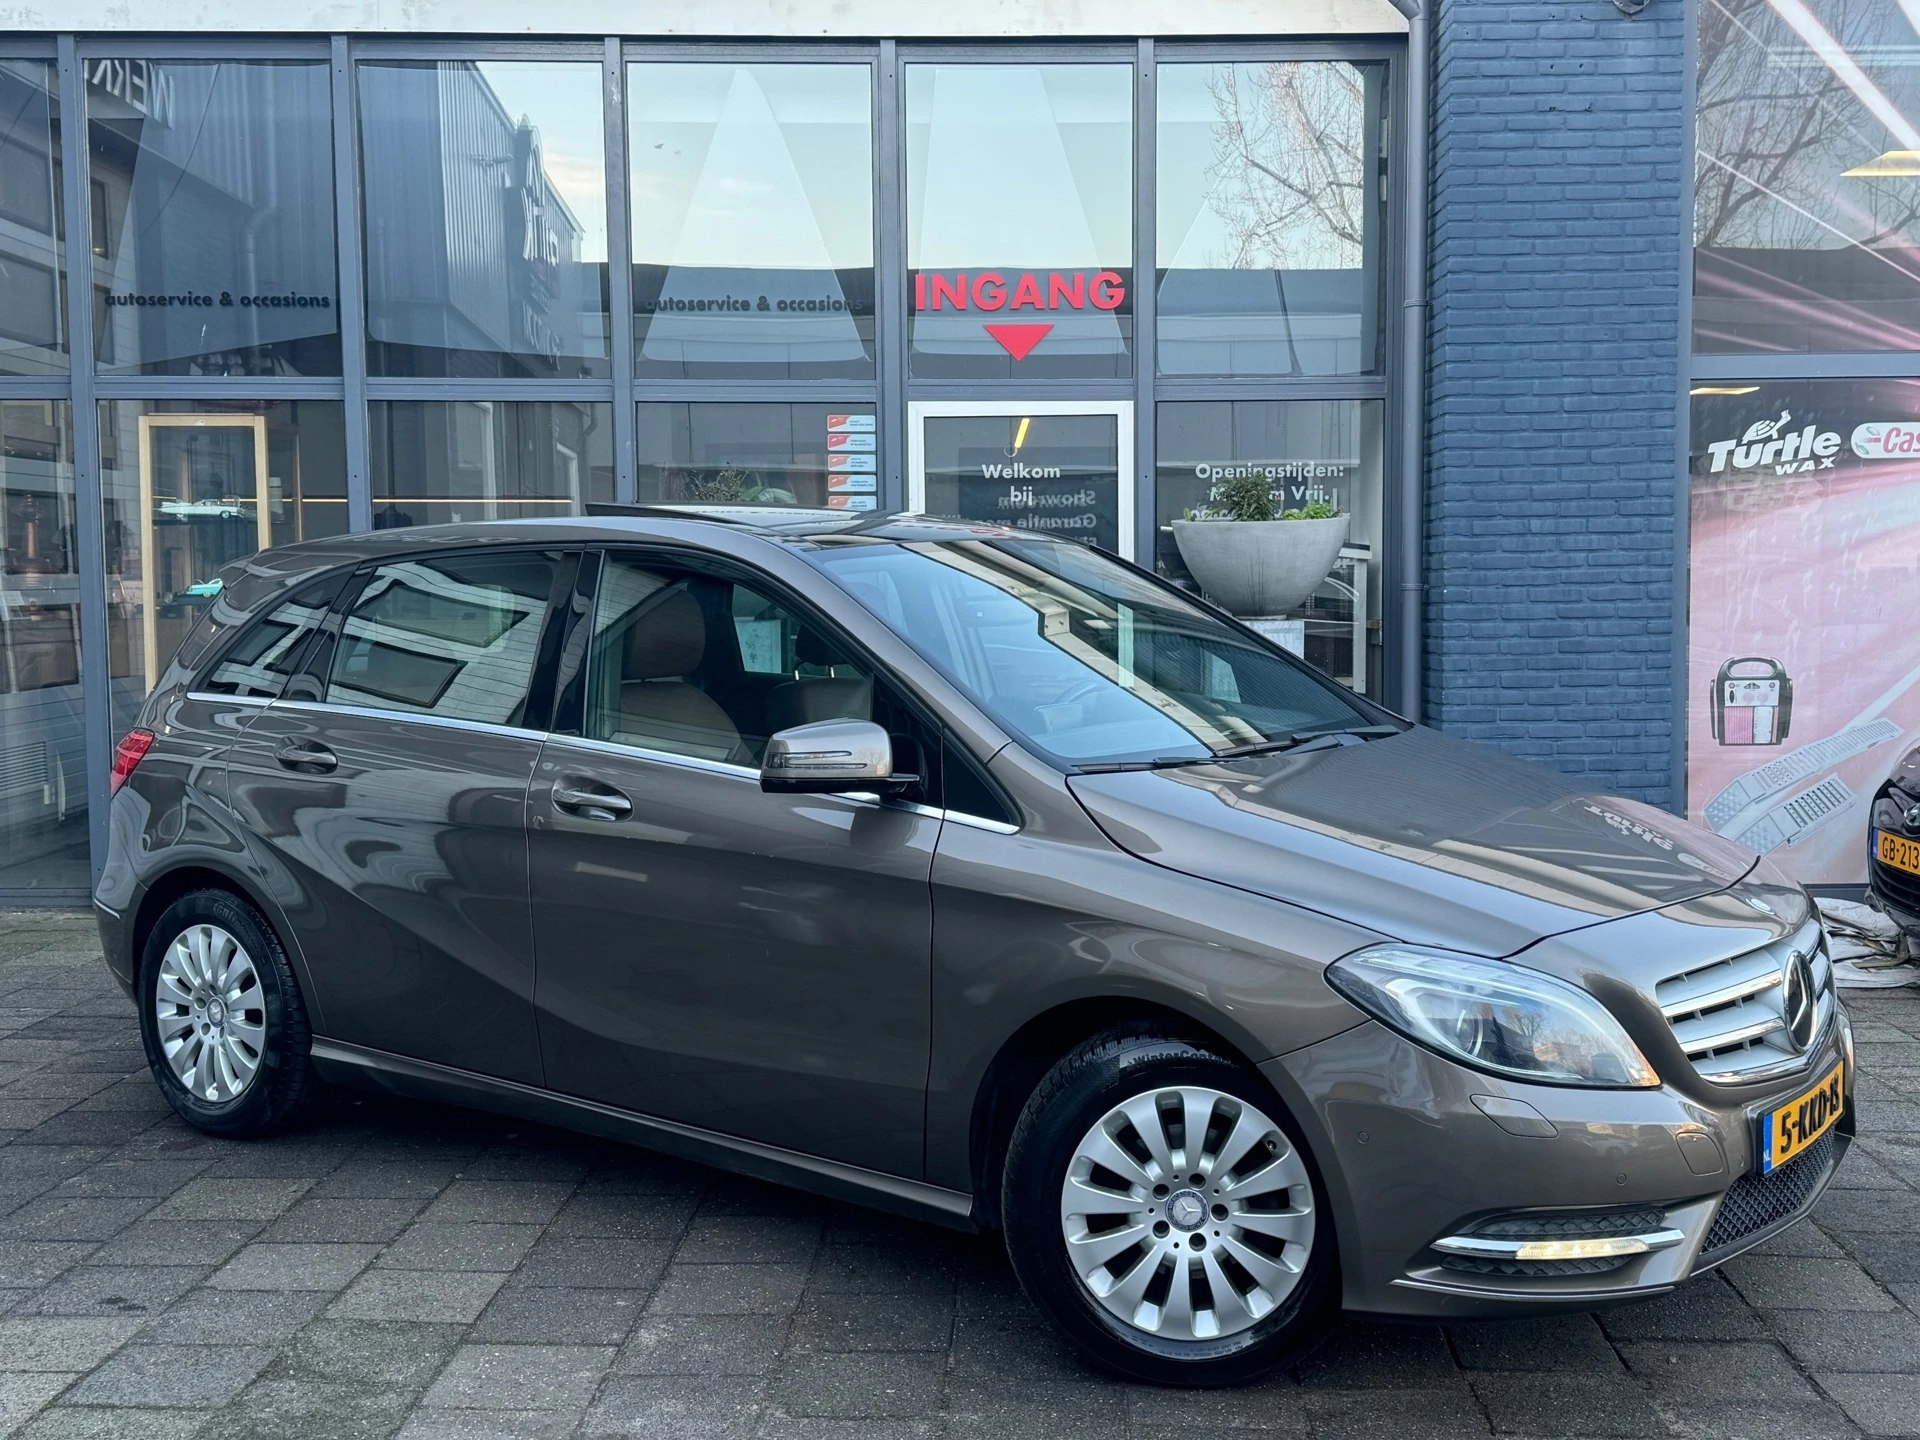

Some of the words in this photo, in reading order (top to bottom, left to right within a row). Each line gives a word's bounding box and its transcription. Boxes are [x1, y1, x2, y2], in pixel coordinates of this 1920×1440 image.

[104, 290, 214, 308] autoservice
[218, 291, 235, 308] &
[240, 291, 331, 309] occasions
[915, 270, 1125, 311] INGANG
[645, 295, 752, 312] autoservice
[756, 295, 771, 312] &
[776, 294, 865, 312] occasions
[1707, 424, 1842, 473] Turtle
[981, 462, 1061, 479] Welkom
[1195, 461, 1345, 483] Openingstijden:
[1775, 456, 1836, 477] WAX
[1010, 485, 1034, 506] bij
[1881, 835, 1920, 870] GB-213
